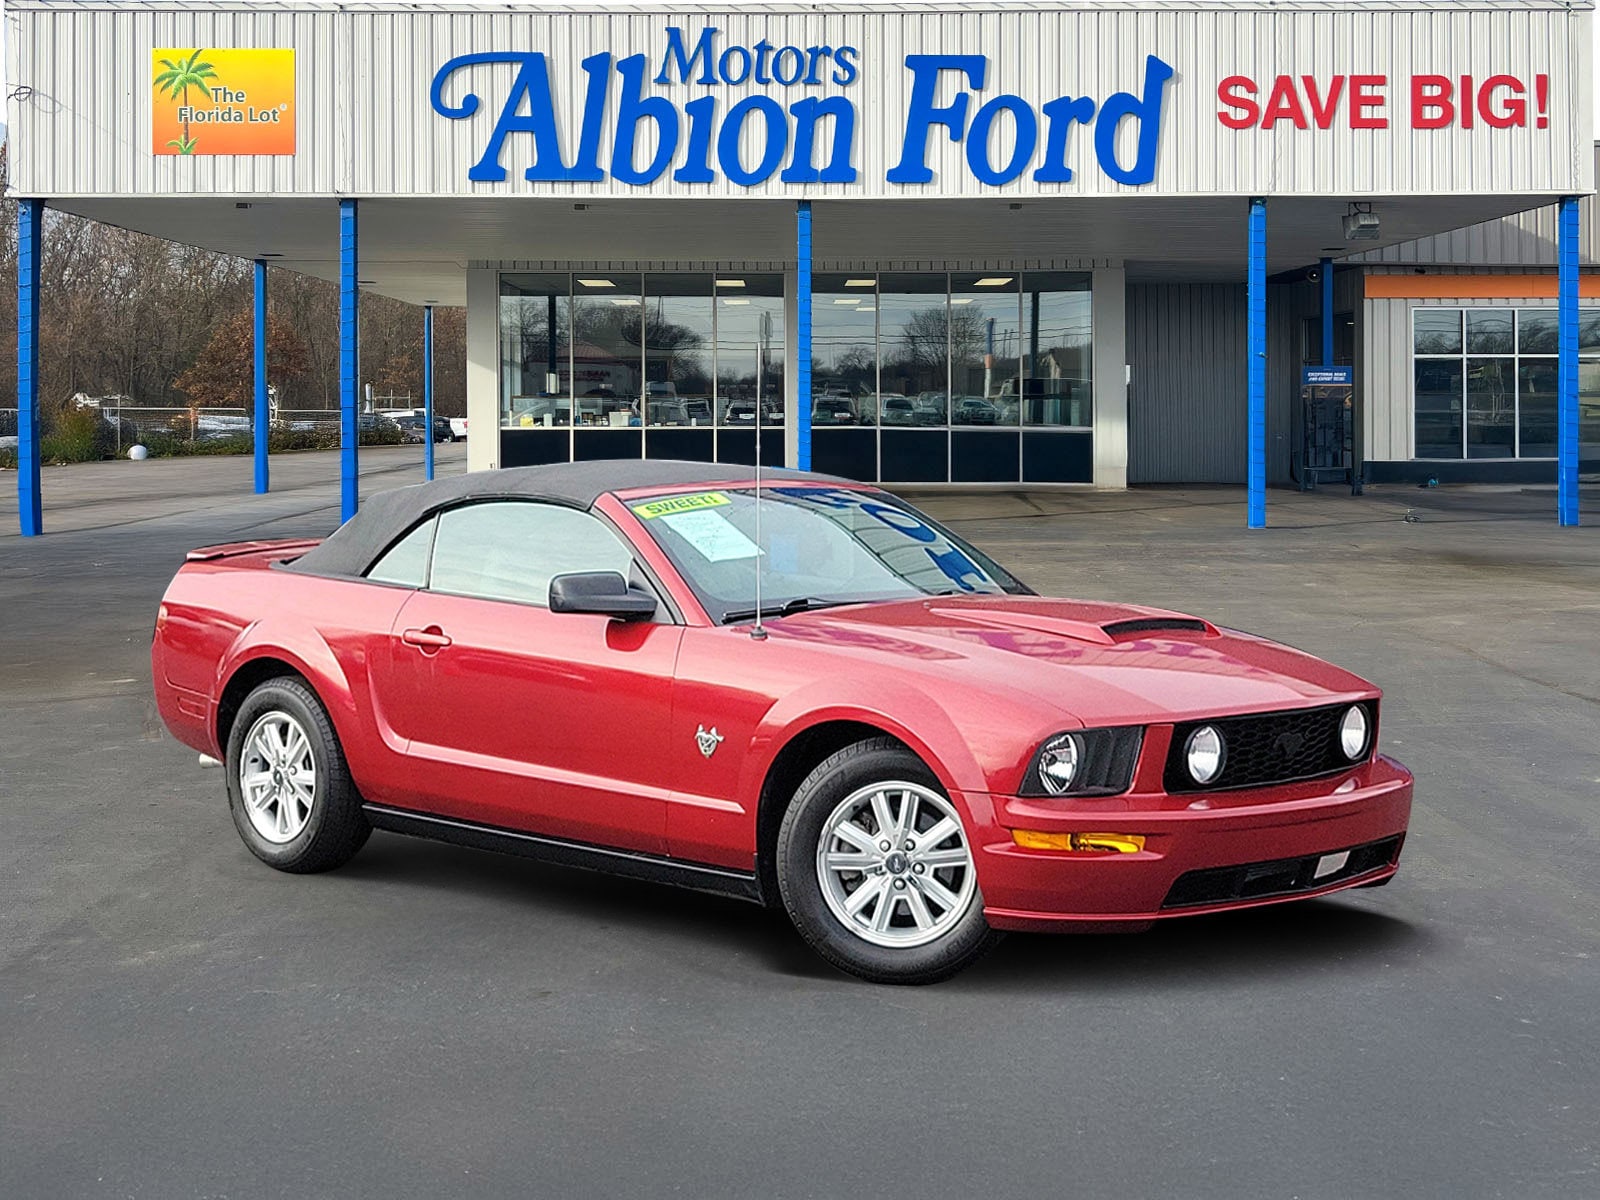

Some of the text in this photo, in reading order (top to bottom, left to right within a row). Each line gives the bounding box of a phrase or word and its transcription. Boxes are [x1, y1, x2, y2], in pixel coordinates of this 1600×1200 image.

[653, 27, 857, 86] Motors
[178, 106, 279, 122] Florida Lot
[211, 87, 246, 103] The
[1217, 74, 1549, 129] SAVE BIG!
[430, 51, 1174, 187] Albion Ford
[644, 494, 719, 515] SWEET!
